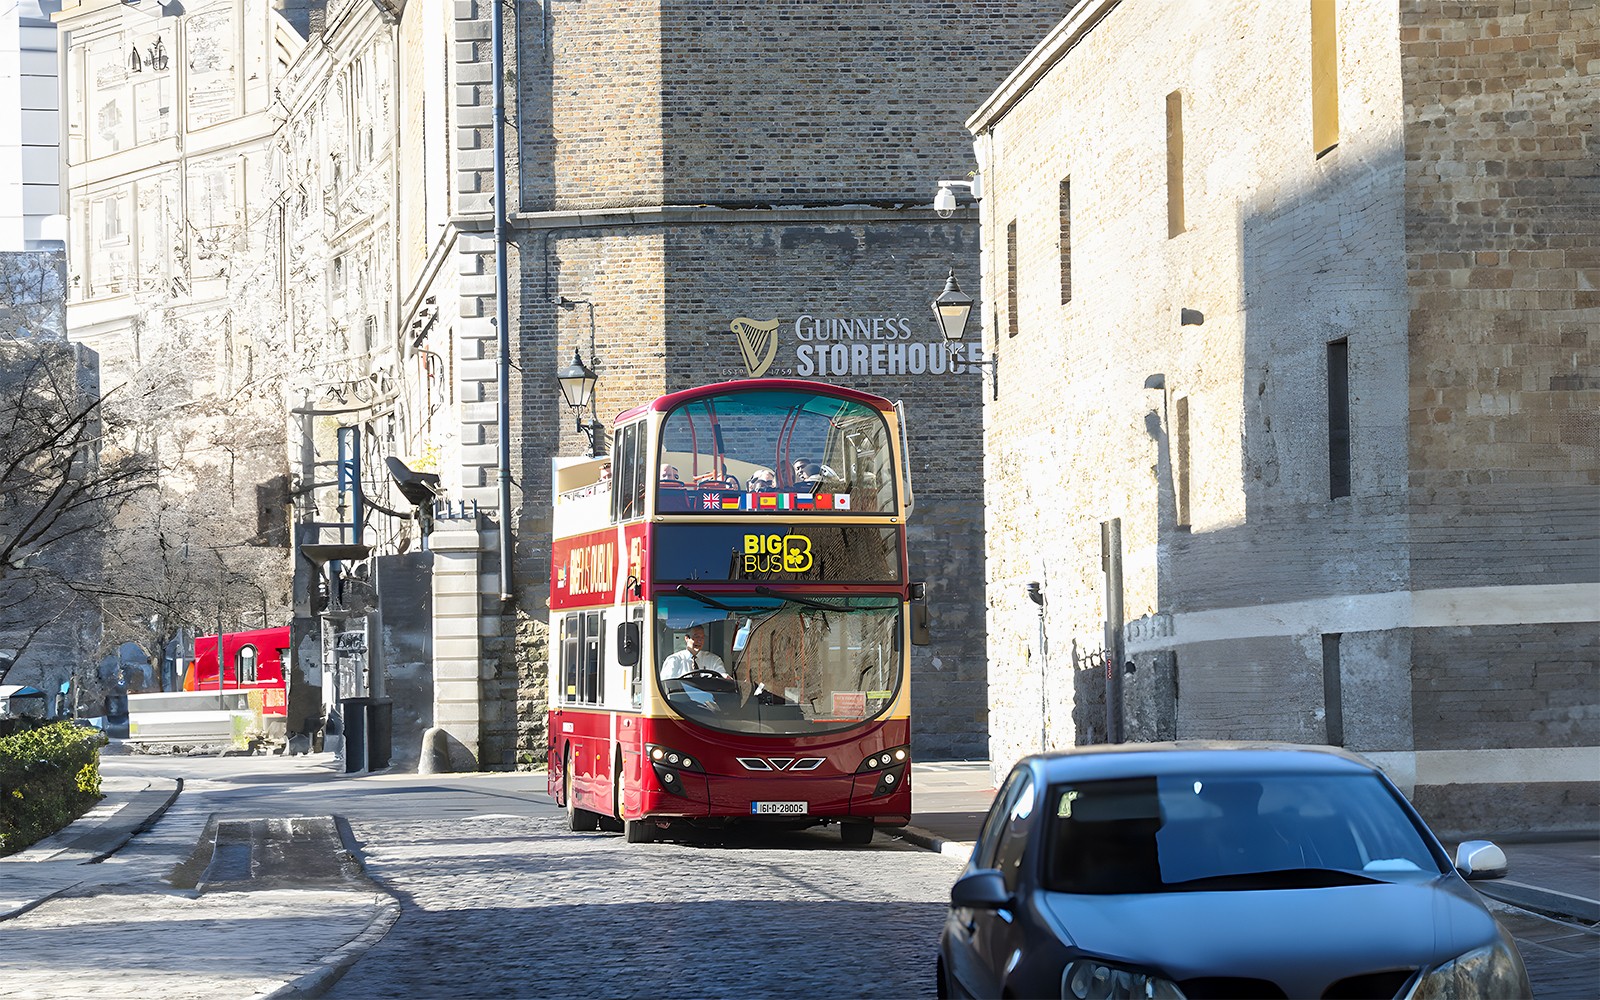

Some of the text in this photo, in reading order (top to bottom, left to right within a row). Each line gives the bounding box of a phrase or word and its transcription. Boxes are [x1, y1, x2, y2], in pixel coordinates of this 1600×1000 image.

[795, 315, 912, 341] GUINNESS
[744, 534, 782, 554] BIG
[744, 555, 783, 572] BUS
